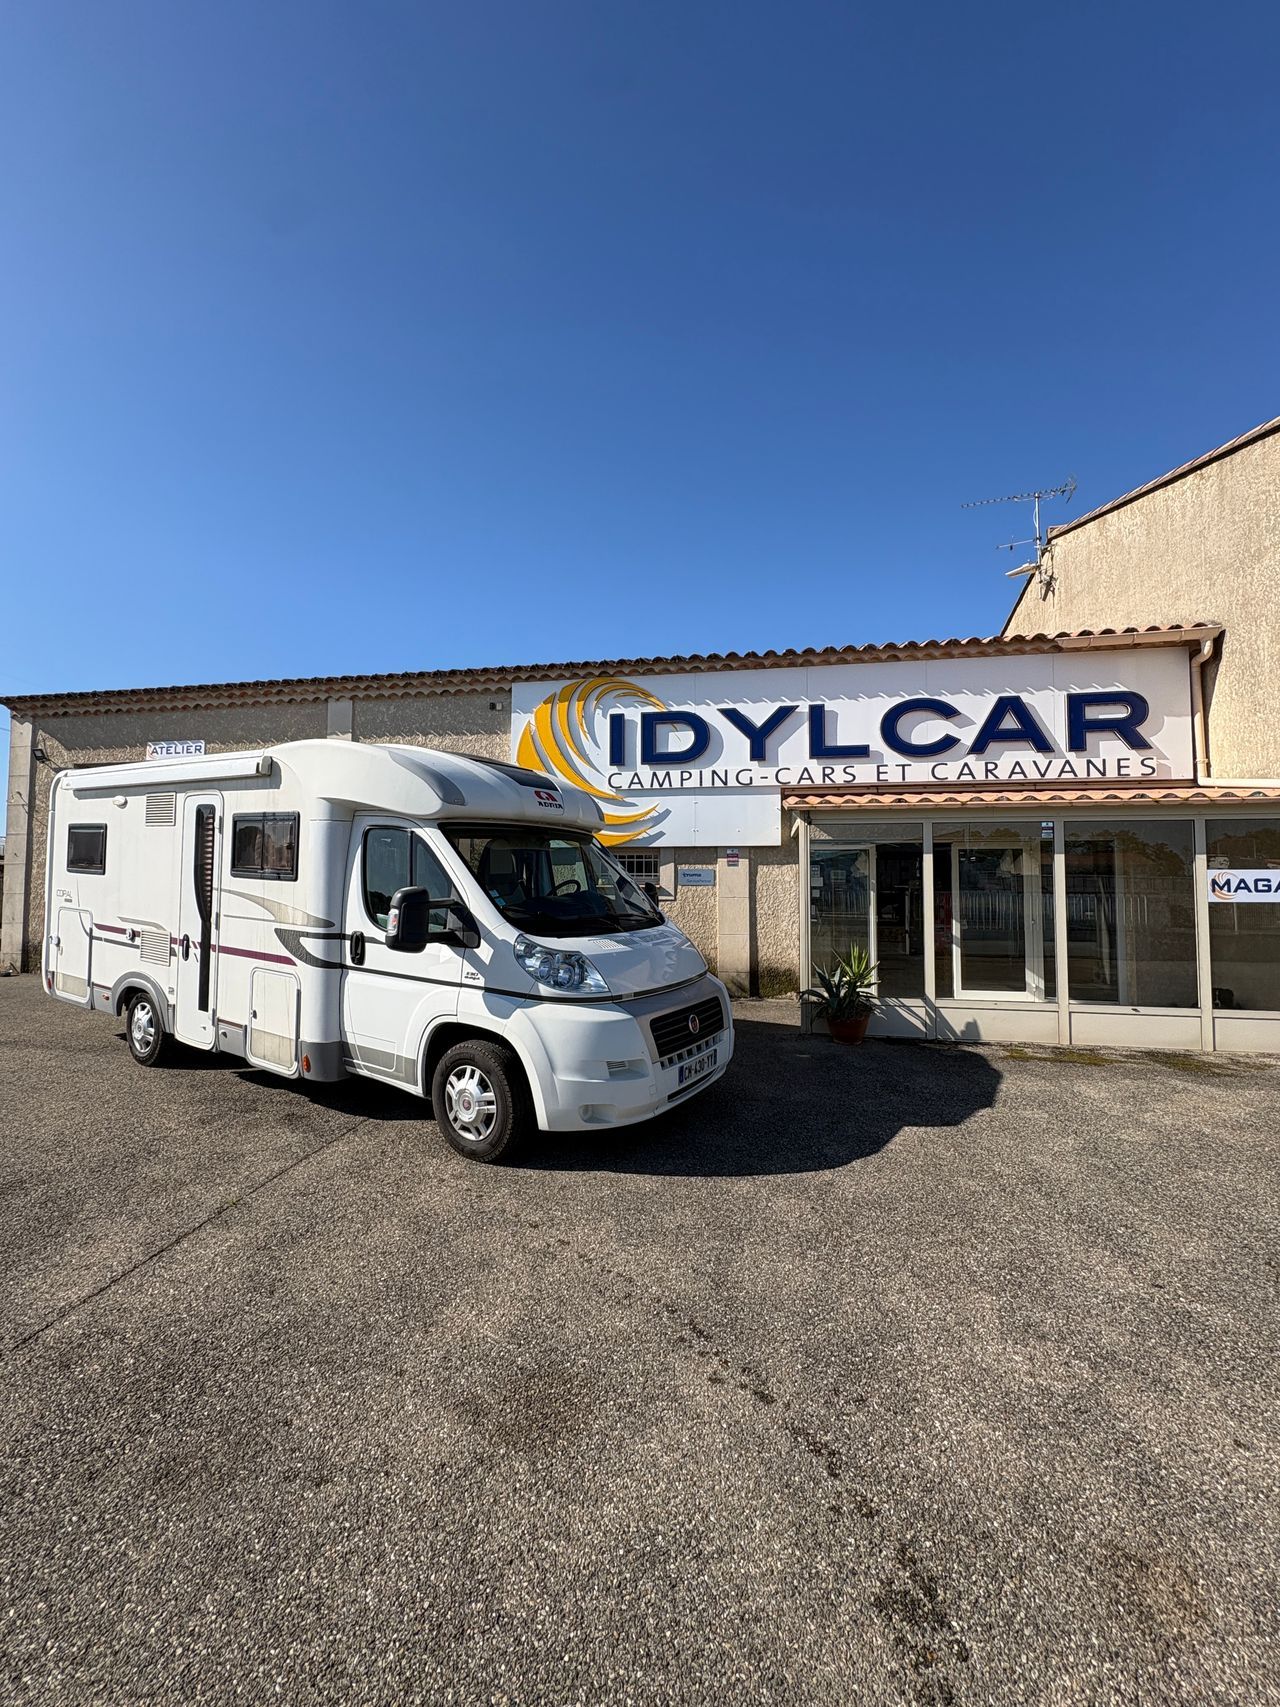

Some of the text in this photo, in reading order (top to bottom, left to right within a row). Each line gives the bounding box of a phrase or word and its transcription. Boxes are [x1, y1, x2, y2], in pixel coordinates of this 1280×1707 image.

[609, 691, 1153, 766] IDYLCAR
[150, 744, 203, 756] ATELIER
[607, 757, 1157, 790] CAMPING-CARS ET CARAVANES
[537, 800, 564, 810] ADRIA
